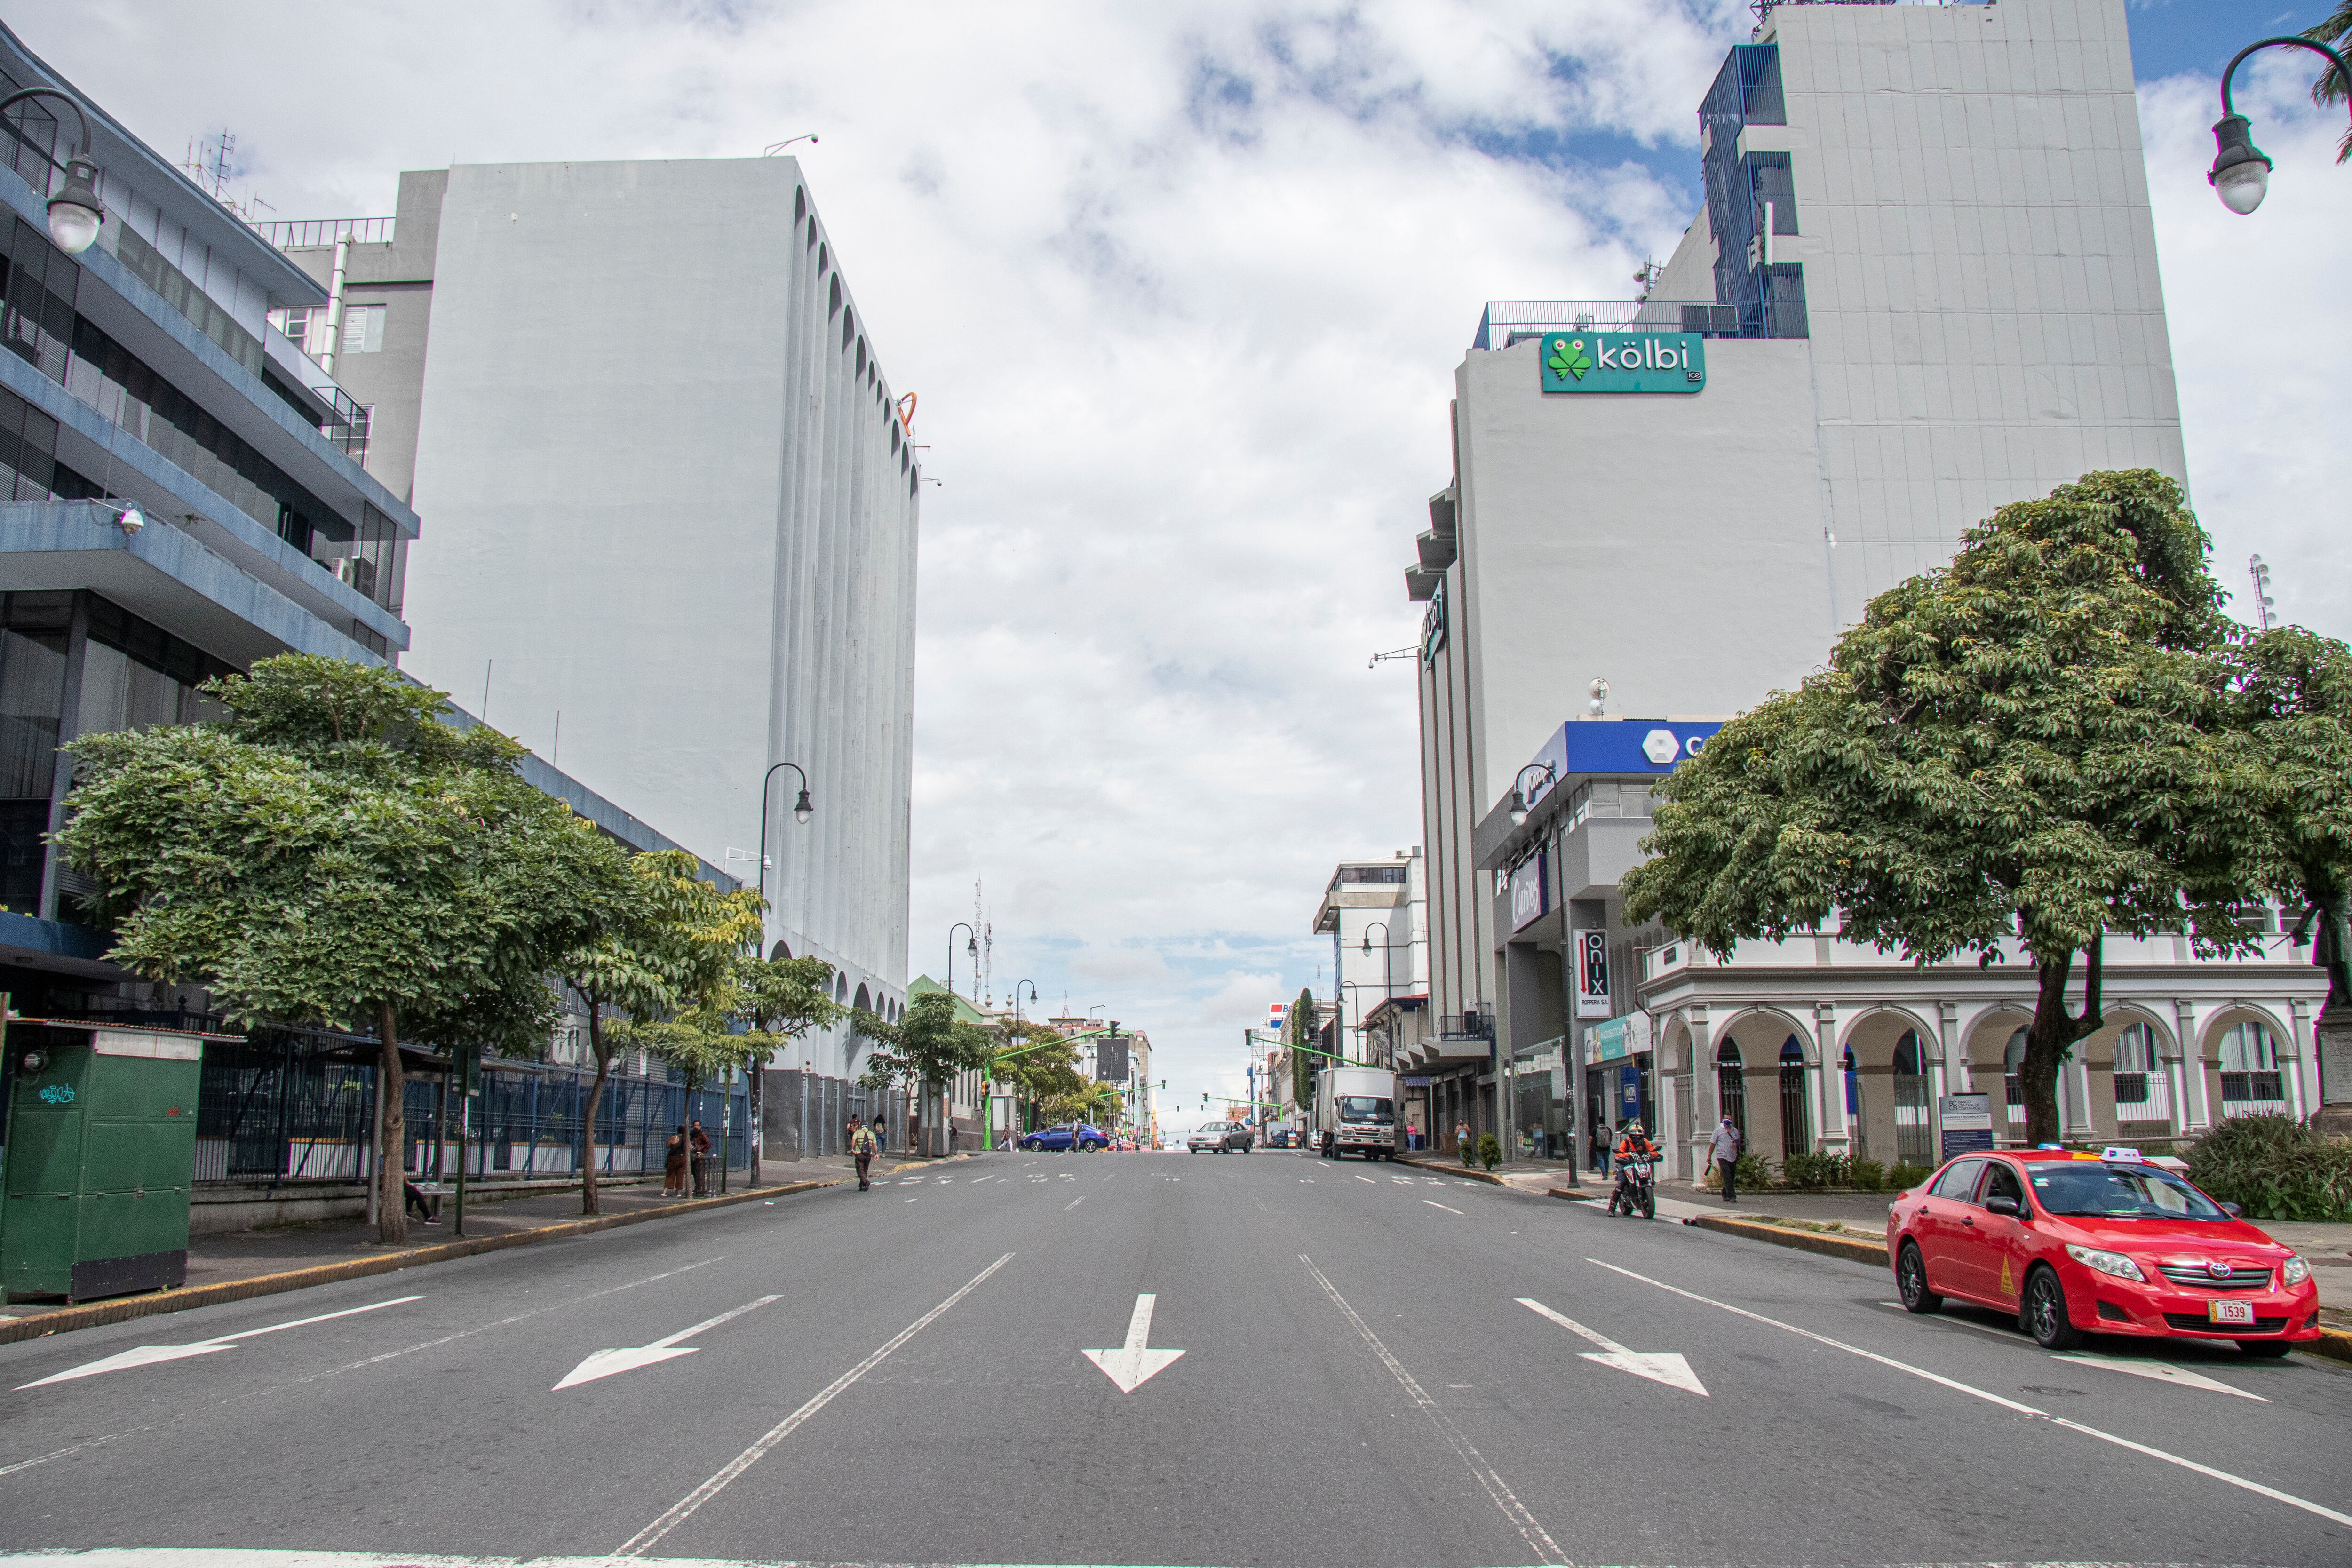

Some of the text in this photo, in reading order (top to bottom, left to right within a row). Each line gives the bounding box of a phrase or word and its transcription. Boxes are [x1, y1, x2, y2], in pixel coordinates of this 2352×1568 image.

[1597, 338, 1688, 369] kölbi
[1512, 876, 1539, 924] Curves
[2223, 1306, 2245, 1318] 1539
